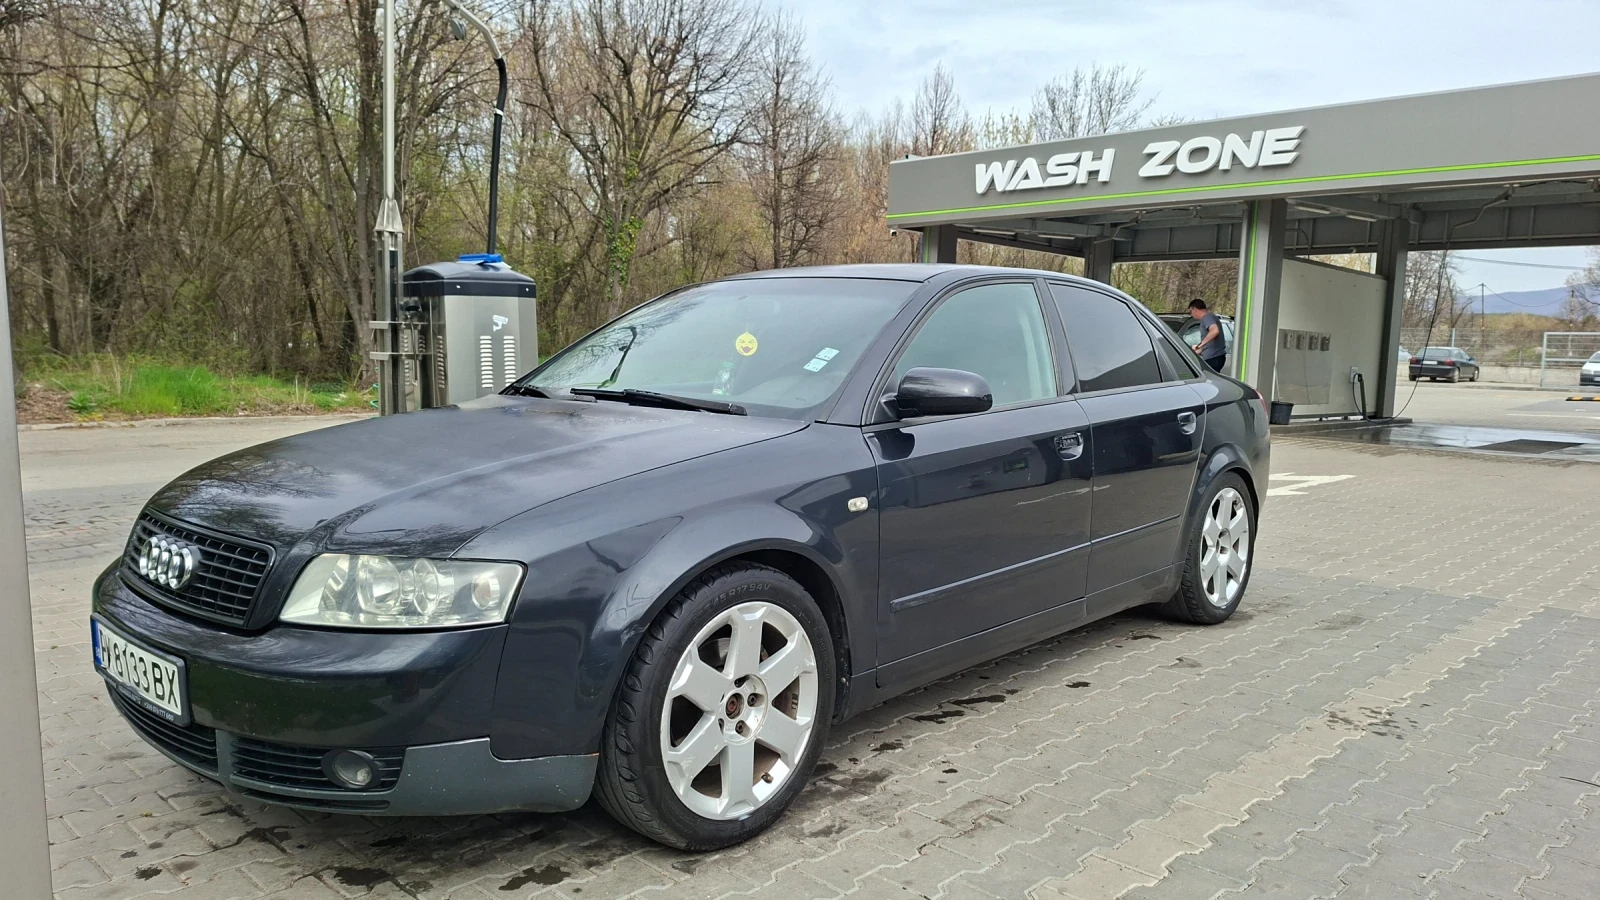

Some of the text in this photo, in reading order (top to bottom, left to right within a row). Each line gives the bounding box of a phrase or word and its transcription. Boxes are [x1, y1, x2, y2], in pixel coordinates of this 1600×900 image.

[975, 125, 1306, 195] WASH ZONE
[749, 583, 772, 593] 94V
[113, 642, 150, 693] 8133
[152, 661, 179, 709] BX
